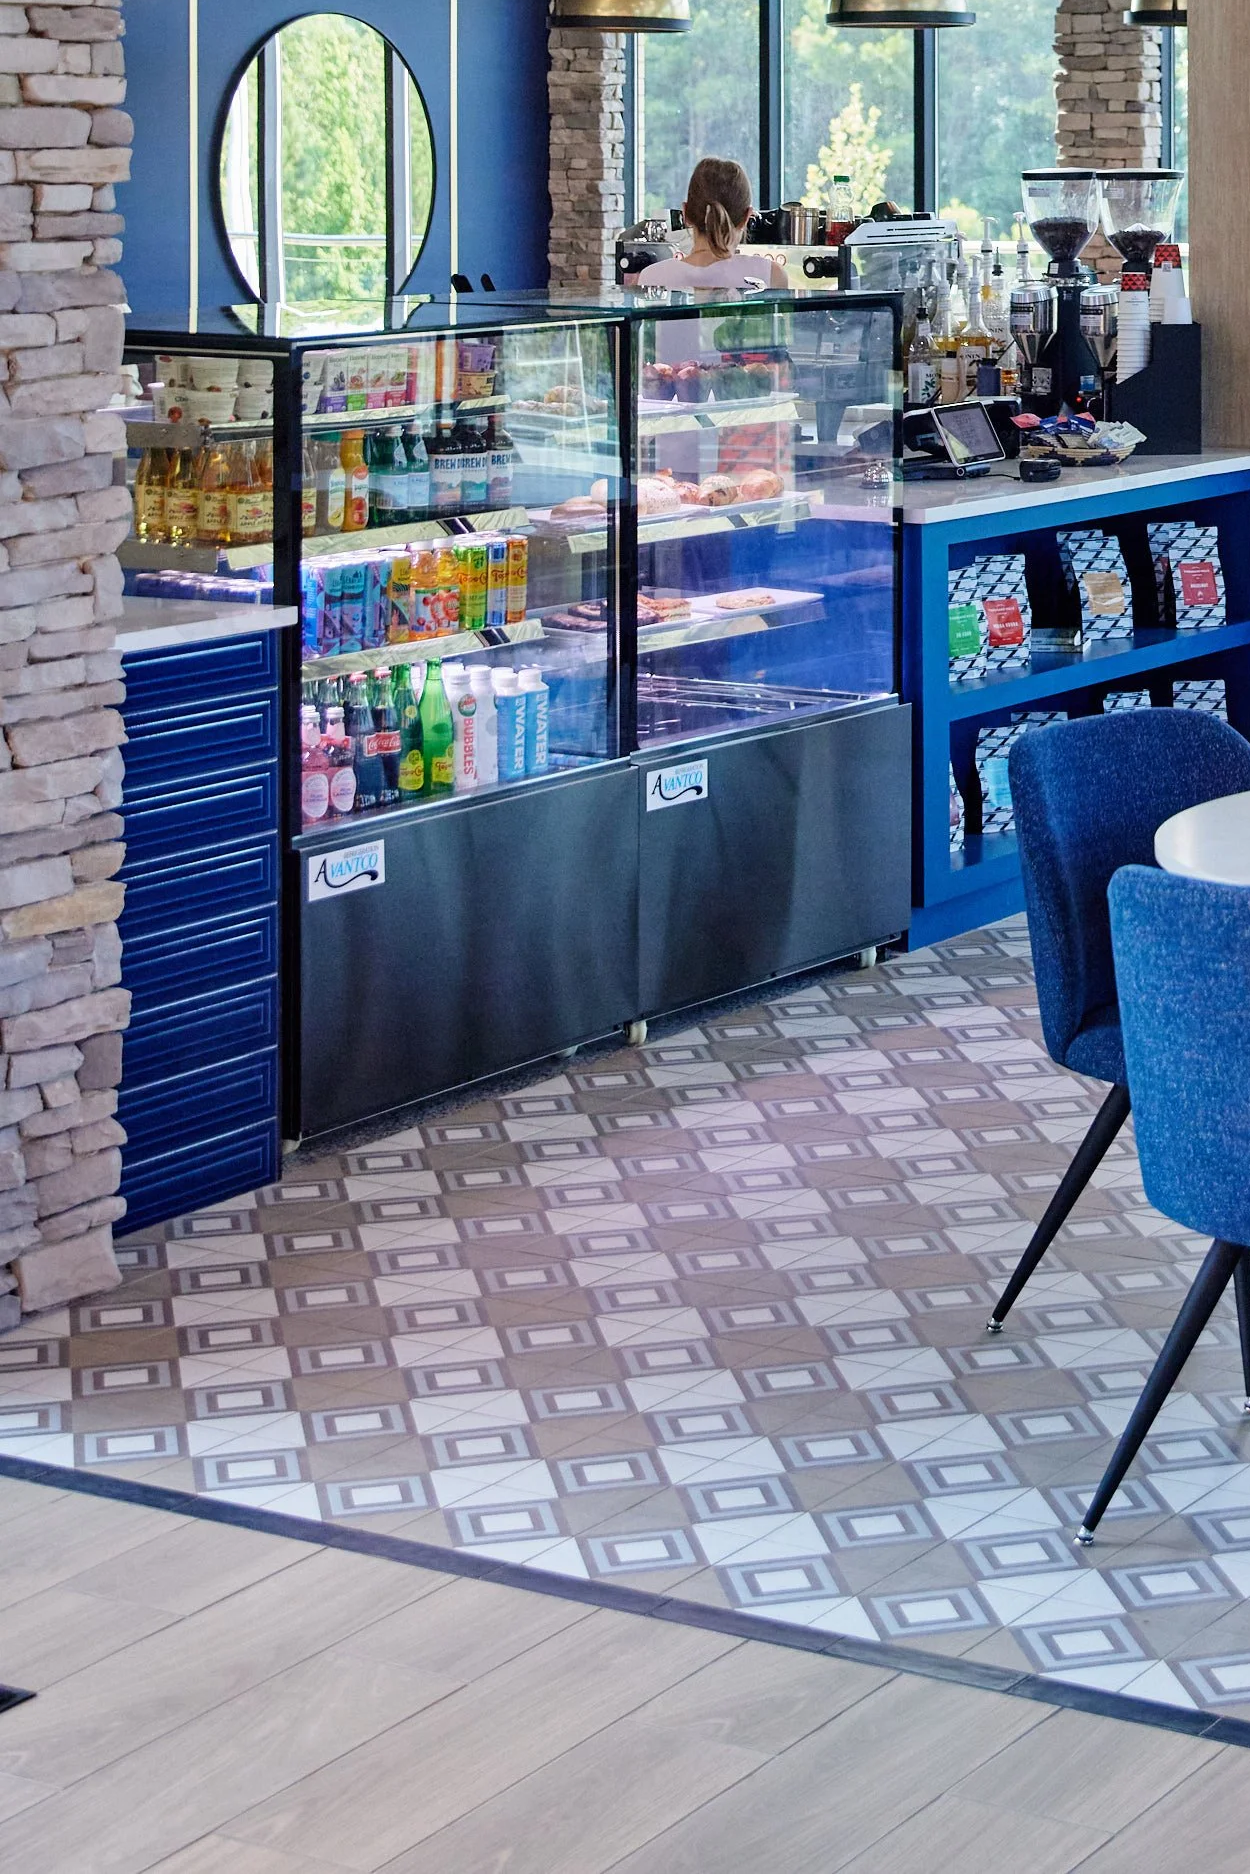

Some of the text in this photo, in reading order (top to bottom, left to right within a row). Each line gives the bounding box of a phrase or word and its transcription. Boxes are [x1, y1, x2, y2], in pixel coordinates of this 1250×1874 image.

[434, 458, 457, 470] BREW
[463, 718, 474, 775] BUBBLES
[651, 771, 703, 801] AVANTCO
[314, 852, 379, 888] AVANTCO
